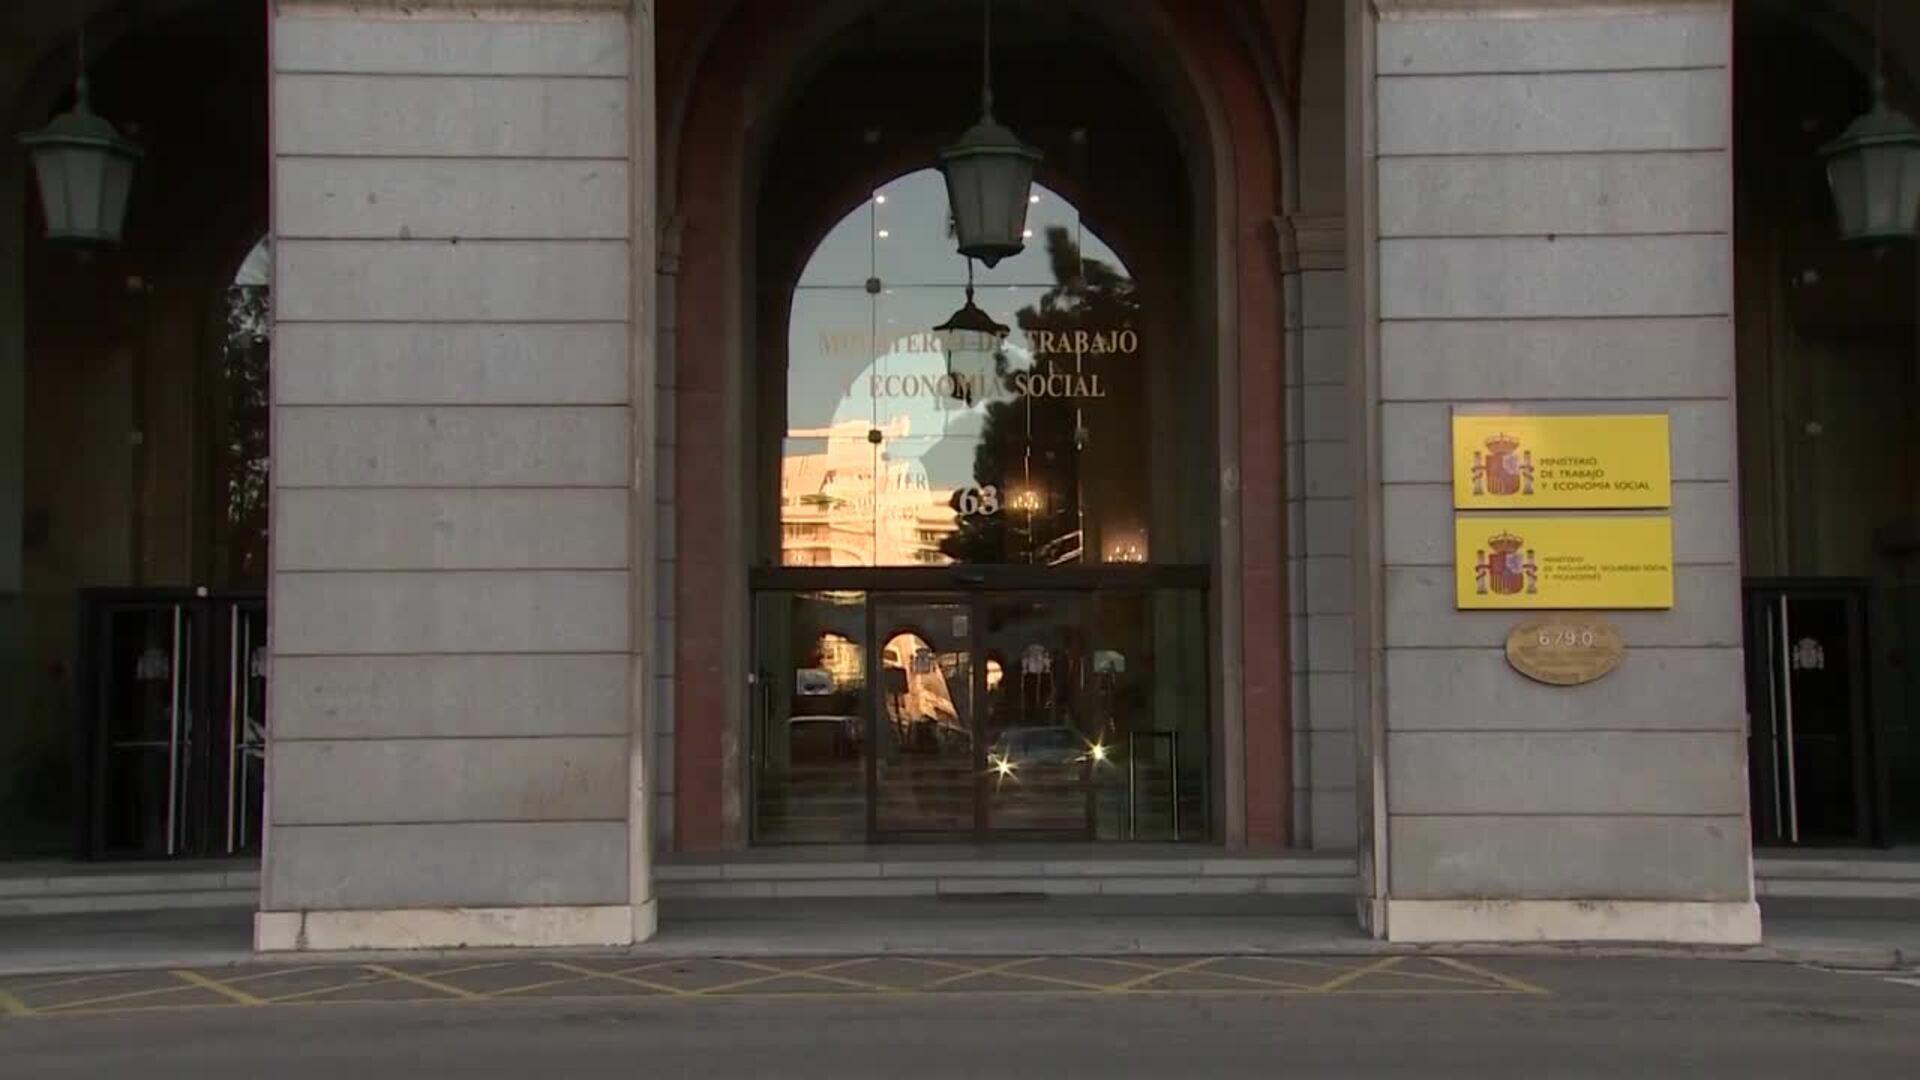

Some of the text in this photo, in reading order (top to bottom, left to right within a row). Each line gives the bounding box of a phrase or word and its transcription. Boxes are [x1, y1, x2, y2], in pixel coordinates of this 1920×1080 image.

[1027, 330, 1139, 353] TRABAJO
[1015, 373, 1107, 398] SOCIAL
[1540, 456, 1598, 466] MINISTERIO
[1540, 469, 1604, 480] DE TRABAJO
[1614, 481, 1650, 491] SOCIAL
[959, 485, 999, 515] 63
